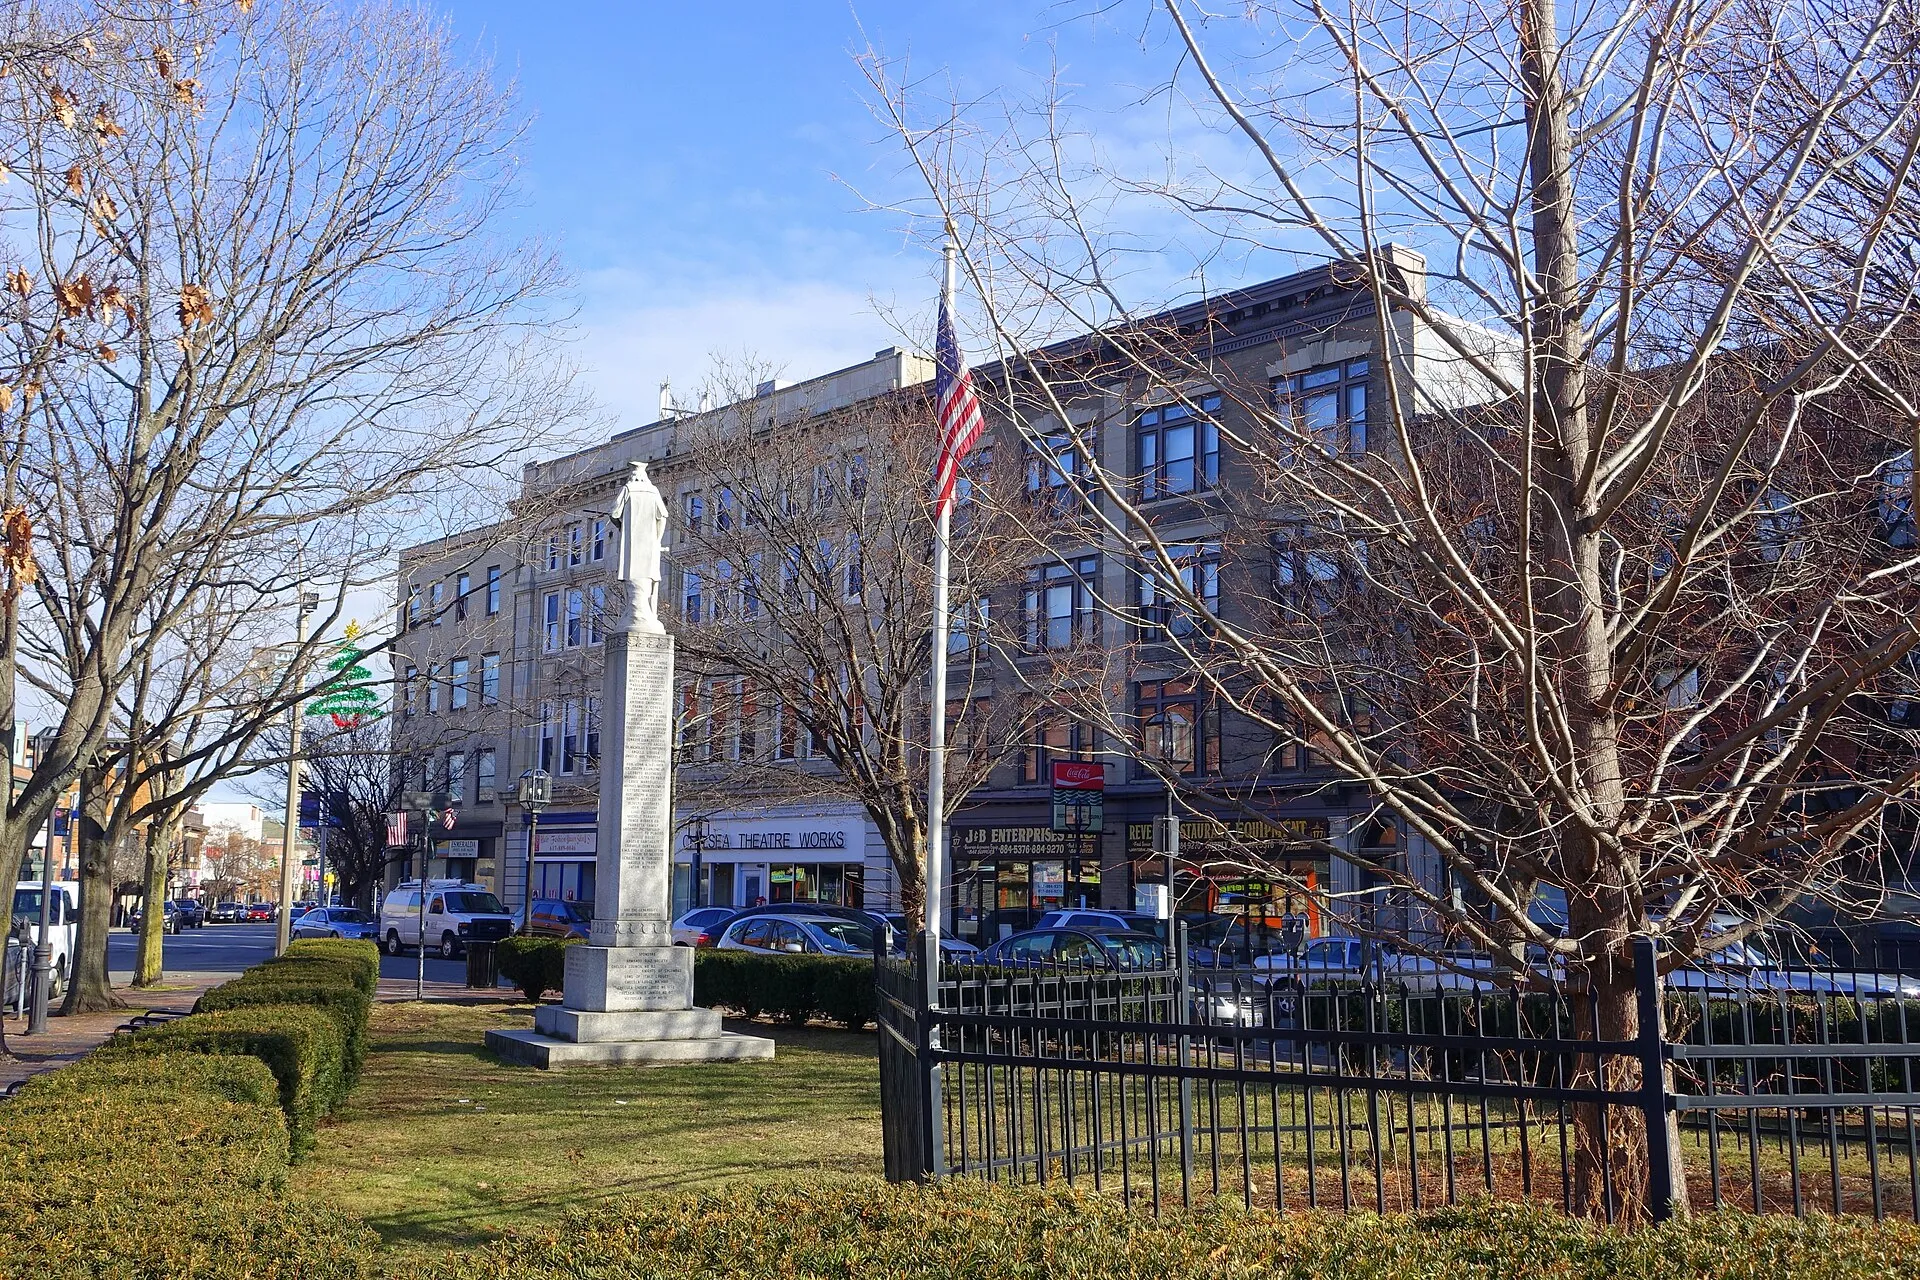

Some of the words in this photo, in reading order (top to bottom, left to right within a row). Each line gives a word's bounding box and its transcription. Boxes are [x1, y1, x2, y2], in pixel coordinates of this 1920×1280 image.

[683, 833, 730, 849] CSEA
[738, 832, 791, 848] THEATRE
[799, 830, 844, 848] WORKS
[965, 829, 986, 843] J&B
[1128, 824, 1154, 840] REVE
